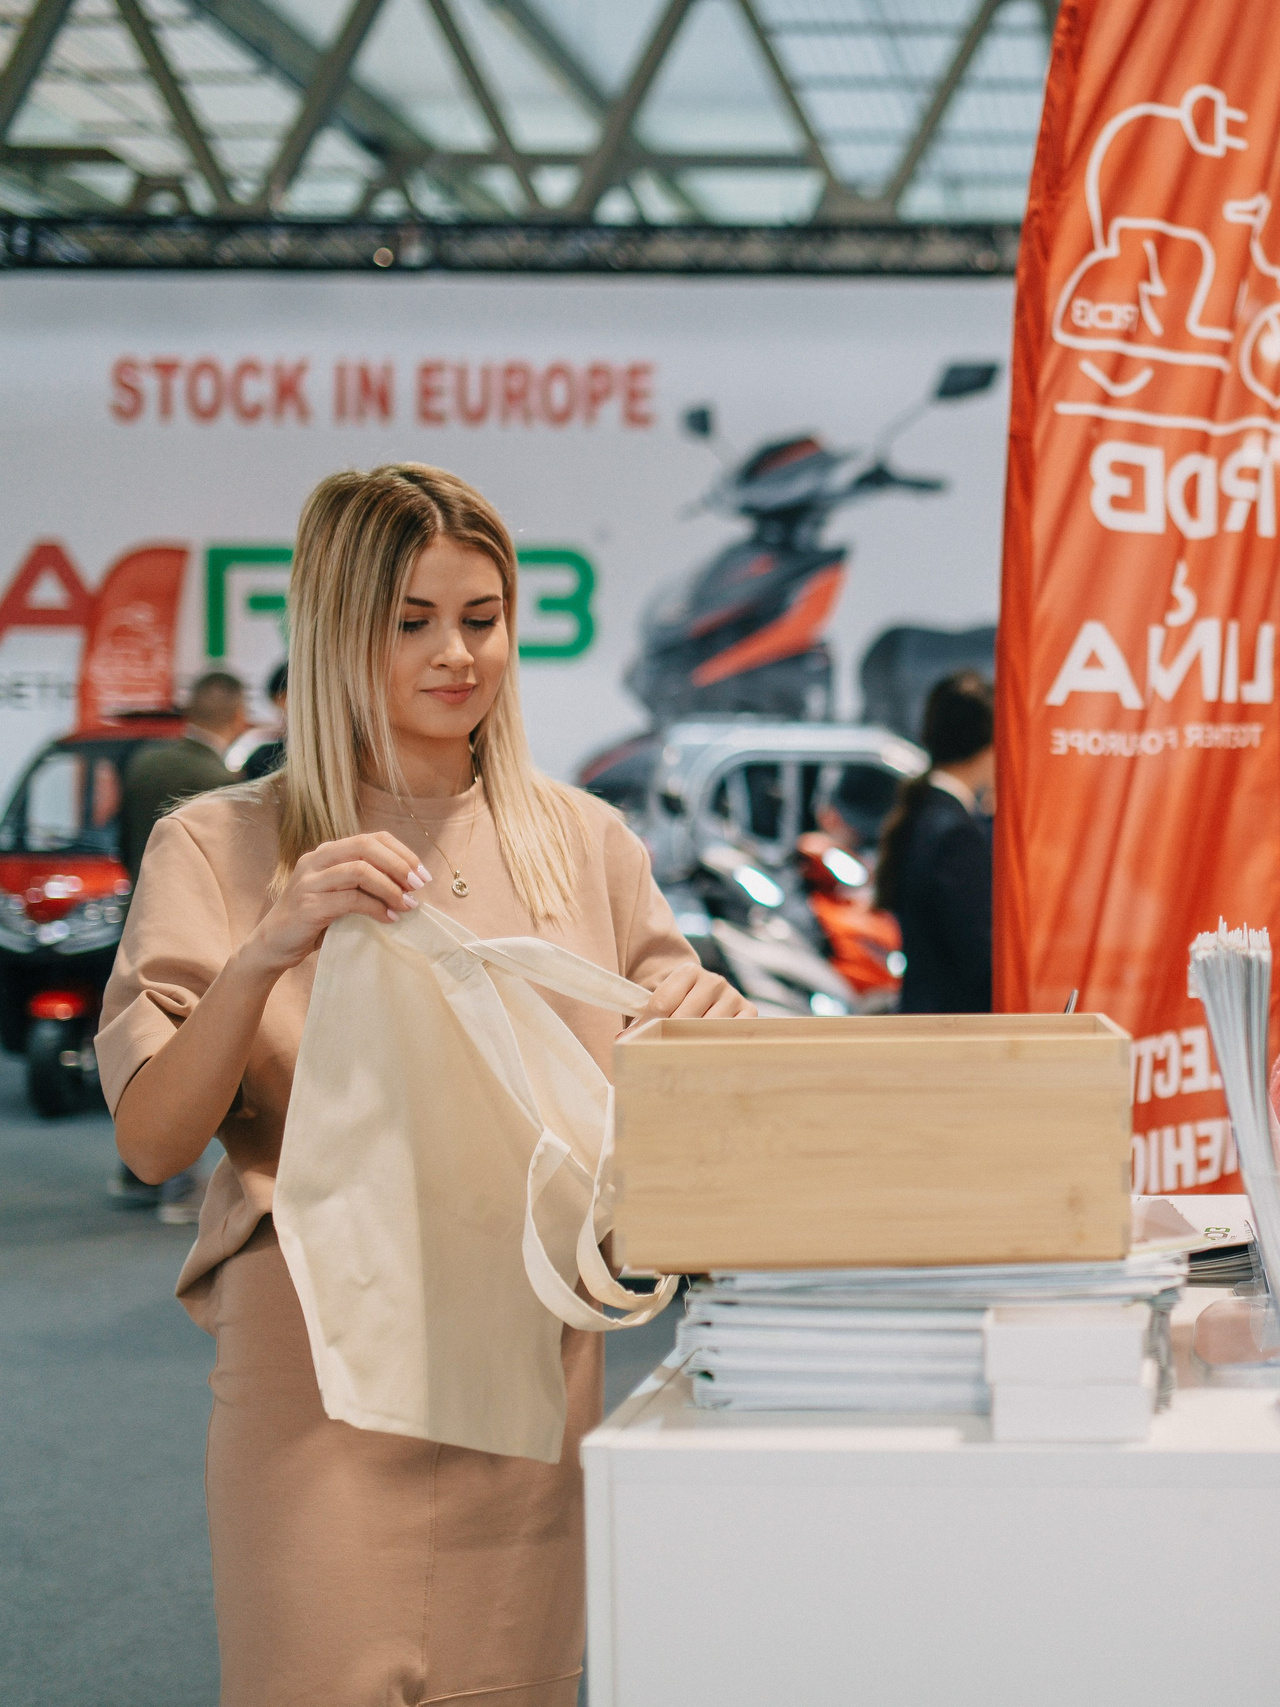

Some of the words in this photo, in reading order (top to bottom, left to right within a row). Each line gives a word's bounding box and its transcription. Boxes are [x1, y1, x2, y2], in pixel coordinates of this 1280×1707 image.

[109, 354, 311, 426] STOCK
[333, 357, 395, 426] IN
[415, 359, 656, 429] EUROPE
